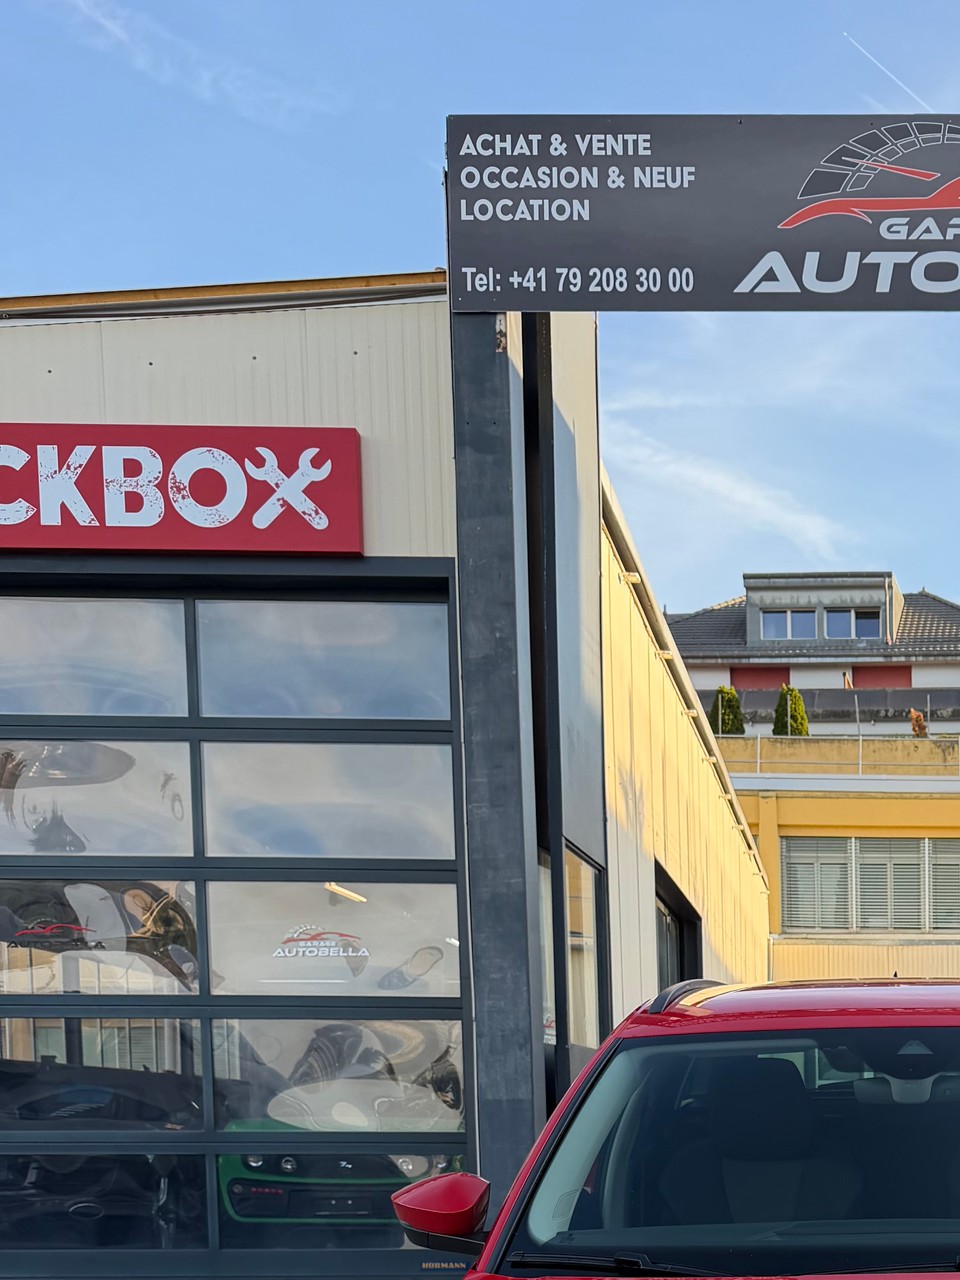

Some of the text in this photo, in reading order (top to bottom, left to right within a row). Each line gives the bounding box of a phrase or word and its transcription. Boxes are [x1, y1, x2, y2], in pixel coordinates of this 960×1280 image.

[459, 133, 652, 157] ACHAT & VENTE
[460, 165, 696, 189] OCCASION & NEUF
[460, 198, 590, 222] LOCATION
[461, 267, 694, 293] Tel: +41 79 208 30 00
[272, 947, 371, 957] AUTOBELLA
